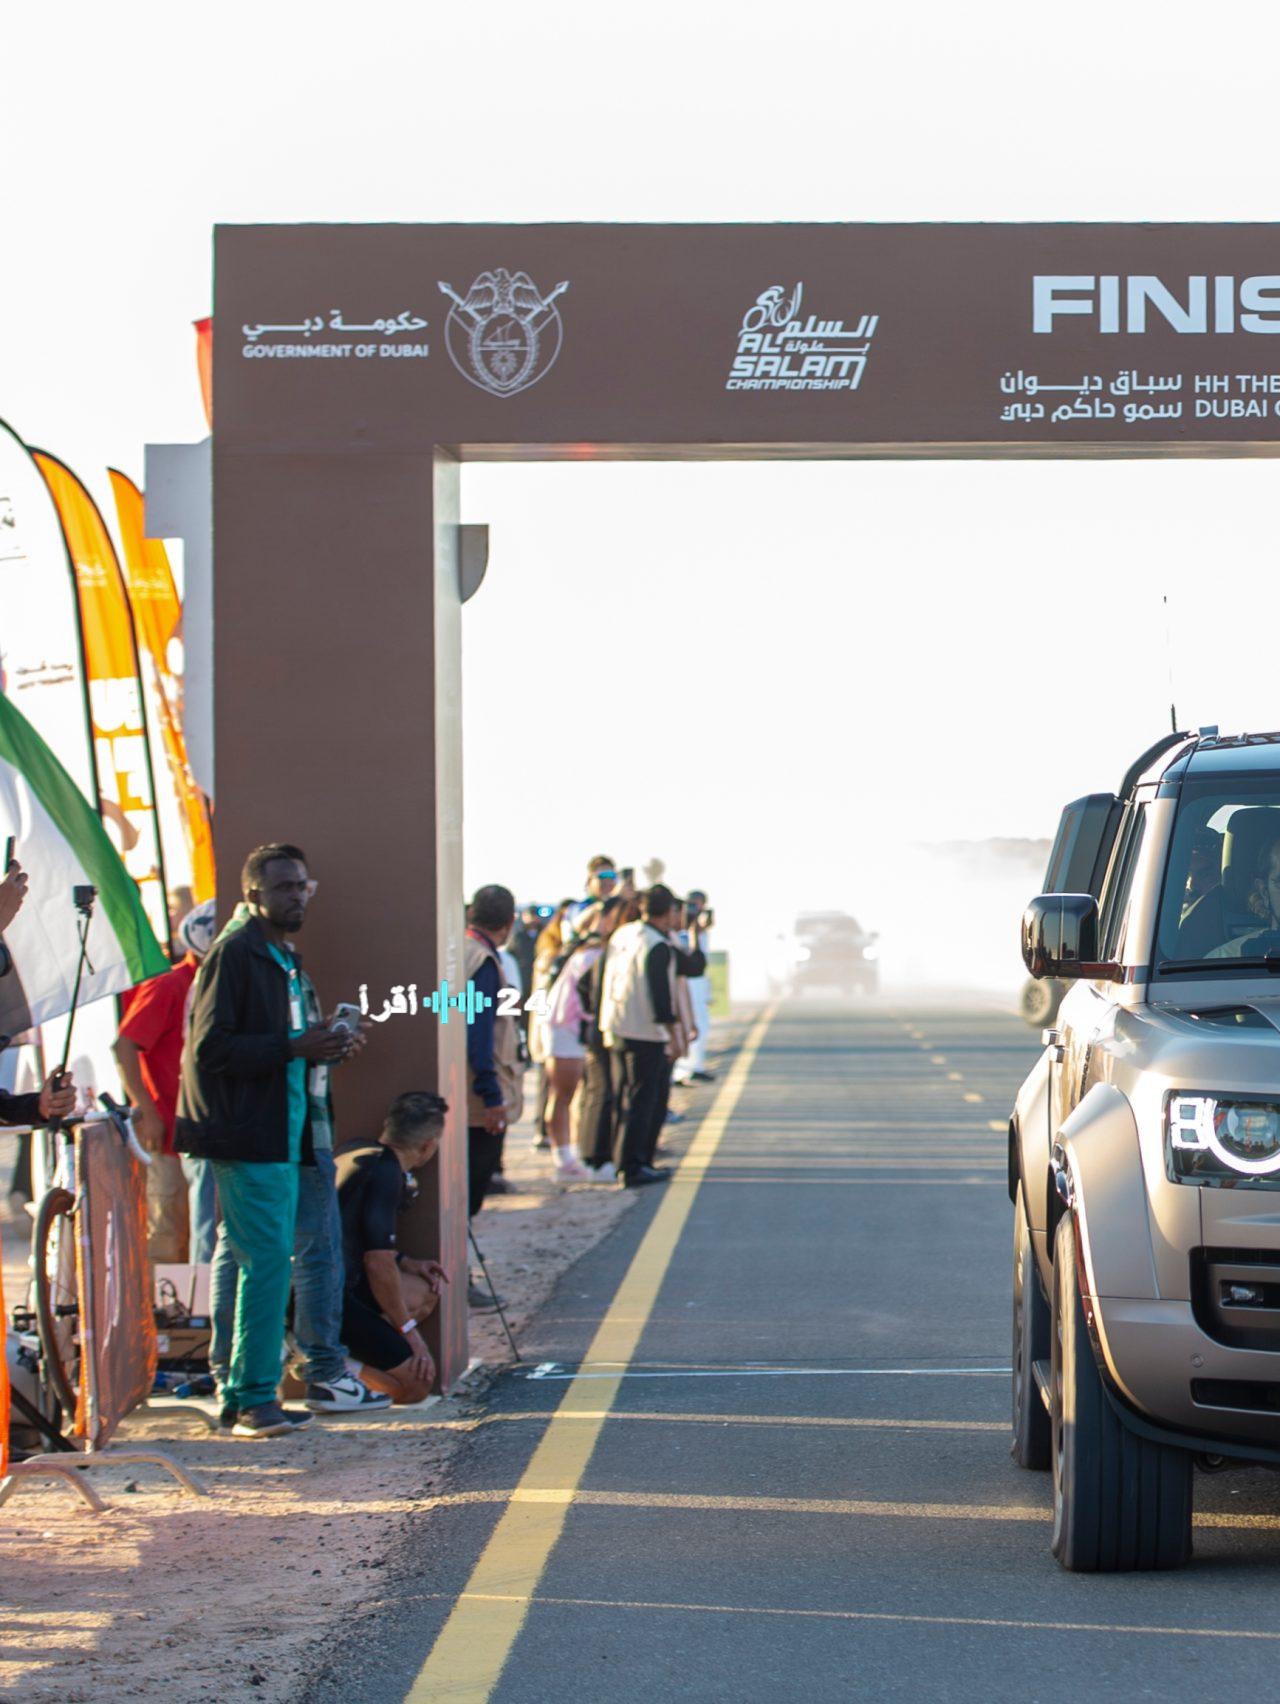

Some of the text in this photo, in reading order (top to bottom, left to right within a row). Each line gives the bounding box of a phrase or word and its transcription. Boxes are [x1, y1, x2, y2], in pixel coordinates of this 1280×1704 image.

[242, 309, 428, 341] حكومة دبي
[242, 344, 428, 358] GOVERNMENT OF DUBAI
[737, 333, 781, 353] AL
[729, 355, 867, 390] SALAM
[1000, 370, 1182, 395] سباق ديوان
[725, 378, 850, 390] CHAMPIONSHIP
[1194, 374, 1229, 393] HH
[1051, 398, 1116, 423] حاكم
[1122, 402, 1183, 423] سمو
[1195, 399, 1268, 418] DUBAI
